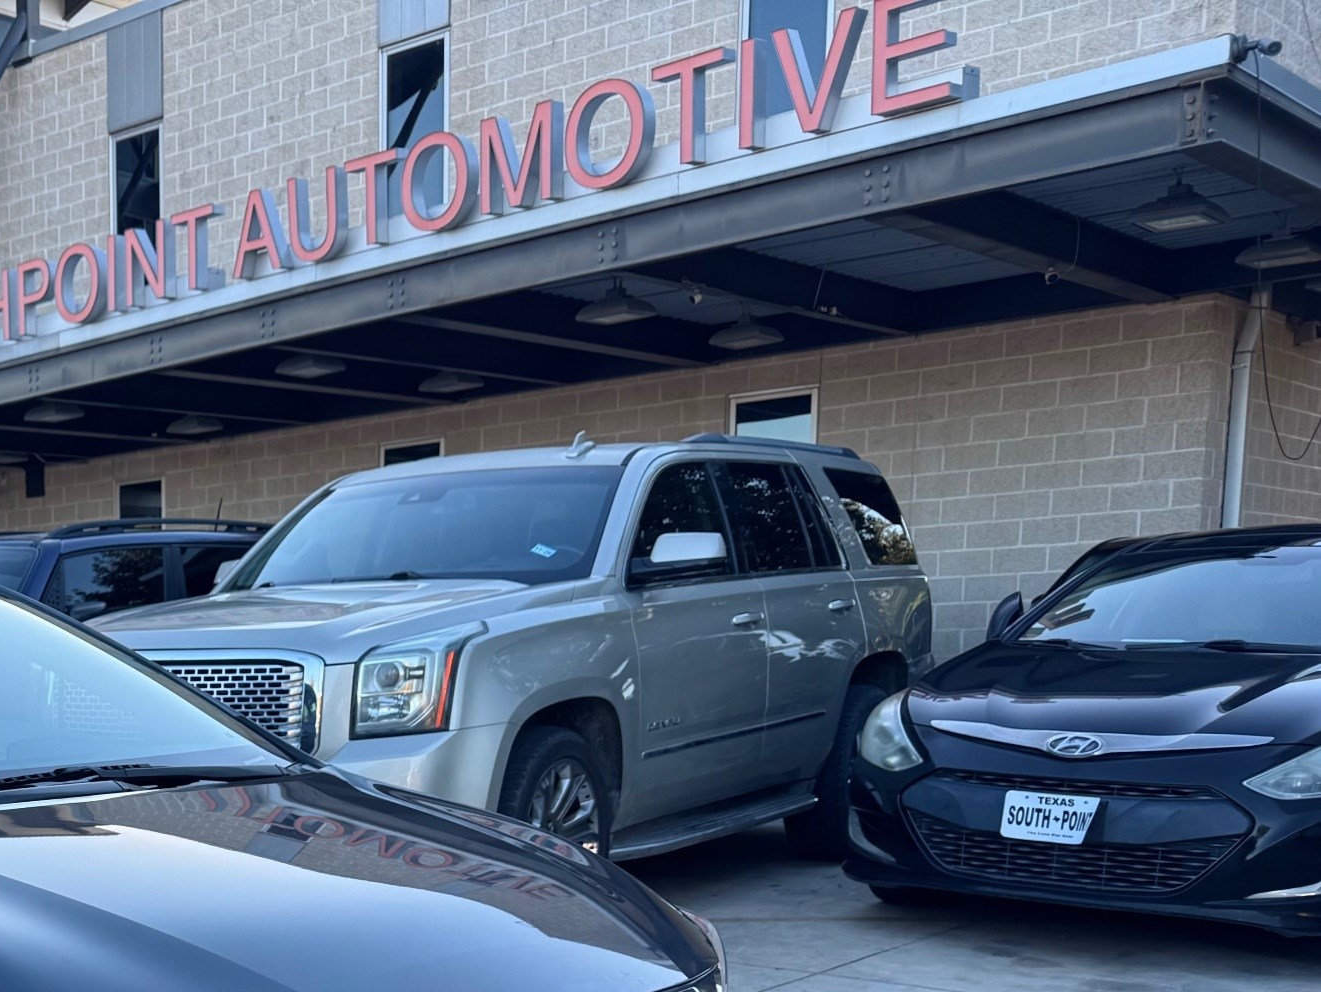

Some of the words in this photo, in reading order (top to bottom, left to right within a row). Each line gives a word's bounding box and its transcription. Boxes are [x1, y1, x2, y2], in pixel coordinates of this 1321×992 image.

[232, 0, 963, 280] AUTOMOTIVE
[1038, 796, 1075, 807] TEXAS
[1007, 805, 1052, 829] SOUTH
